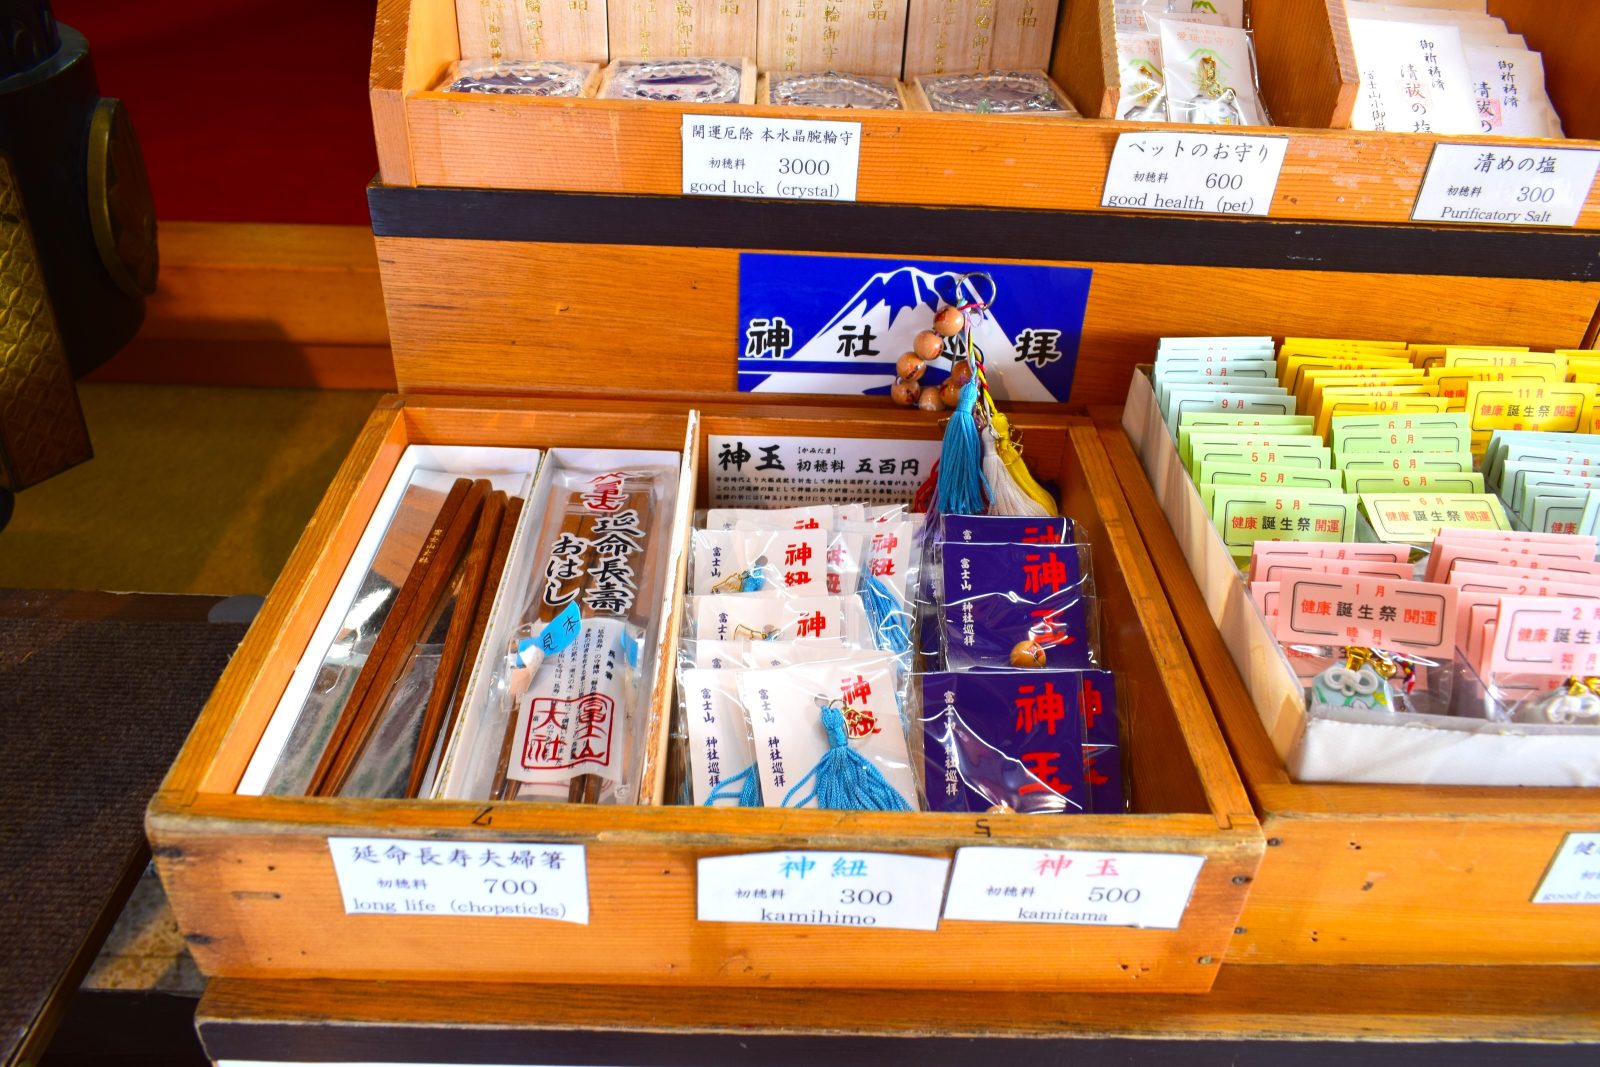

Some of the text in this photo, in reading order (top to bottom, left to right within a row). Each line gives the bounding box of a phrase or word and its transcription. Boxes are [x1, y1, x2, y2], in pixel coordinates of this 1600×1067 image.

[691, 124, 854, 147] 開運厄除 本水晶腕輪守
[1128, 139, 1270, 164] ペットのお守り
[708, 157, 830, 176] 初穂料 3000
[1473, 152, 1558, 174] 清めの塩
[690, 180, 840, 199] good luck (crystal)
[1132, 170, 1243, 191] 初穂料 600
[1107, 193, 1254, 215] good health (pet)
[1447, 184, 1555, 203] 初穂料 300
[1440, 206, 1552, 223] Purificatory Salt
[718, 441, 785, 472] 神玉
[797, 458, 920, 476] 初穂料 五百円
[545, 535, 585, 605] おはし
[711, 546, 722, 577] 富士山
[960, 557, 976, 646] 富士山 神社巡拝
[1553, 627, 1600, 645] 誕生
[700, 687, 721, 787] 富士山 神社巡拝
[758, 688, 786, 788] 富士山 神社巡拝
[1015, 681, 1072, 796] 神玉
[352, 843, 566, 870] 延命長寿夫婦箸
[778, 855, 869, 880] 神紐
[1034, 853, 1120, 878] 神玉
[377, 878, 538, 896] 初穂料 700
[734, 887, 893, 906] 初穂料 300
[985, 885, 1142, 904] 初穂料 500
[353, 898, 567, 918] long life (chopsticks)
[760, 908, 877, 925] kamihimo
[1018, 907, 1109, 922] kamitama
